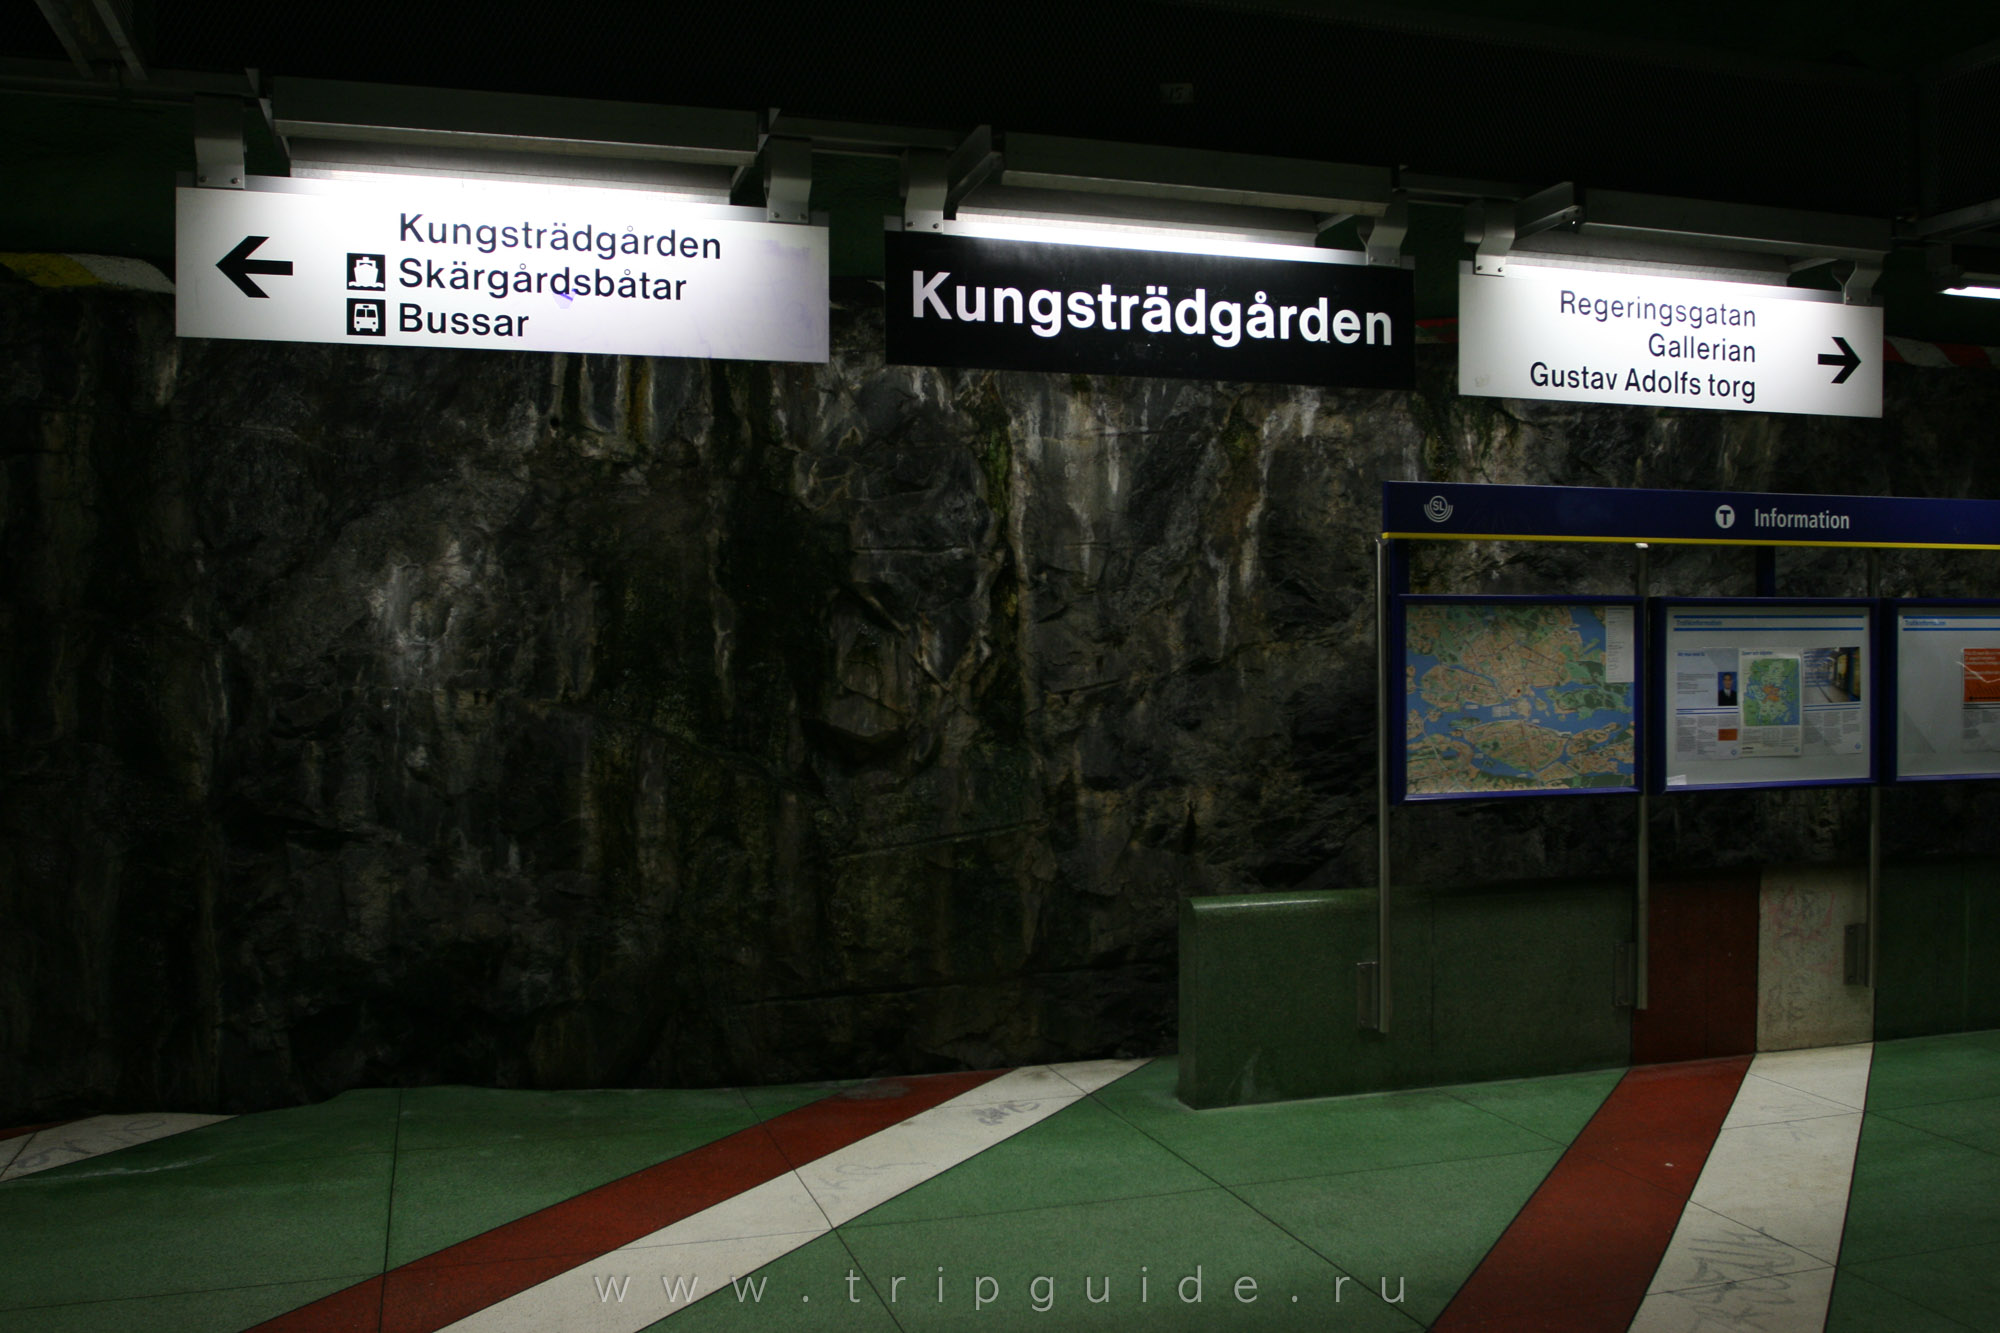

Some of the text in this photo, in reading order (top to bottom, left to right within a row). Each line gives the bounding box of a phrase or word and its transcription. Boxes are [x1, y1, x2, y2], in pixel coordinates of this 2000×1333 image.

[400, 213, 721, 260] Kungsträdgården
[399, 257, 687, 301] Skärgårdsbåtar
[399, 302, 529, 337] Bussar
[912, 270, 1393, 348] Kungsträdgården
[1560, 291, 1756, 329] Regeringsgatan
[1648, 333, 1756, 363] Gallerian
[1530, 361, 1756, 404] Gustav Adolfs torg
[1754, 507, 1850, 530] Information
